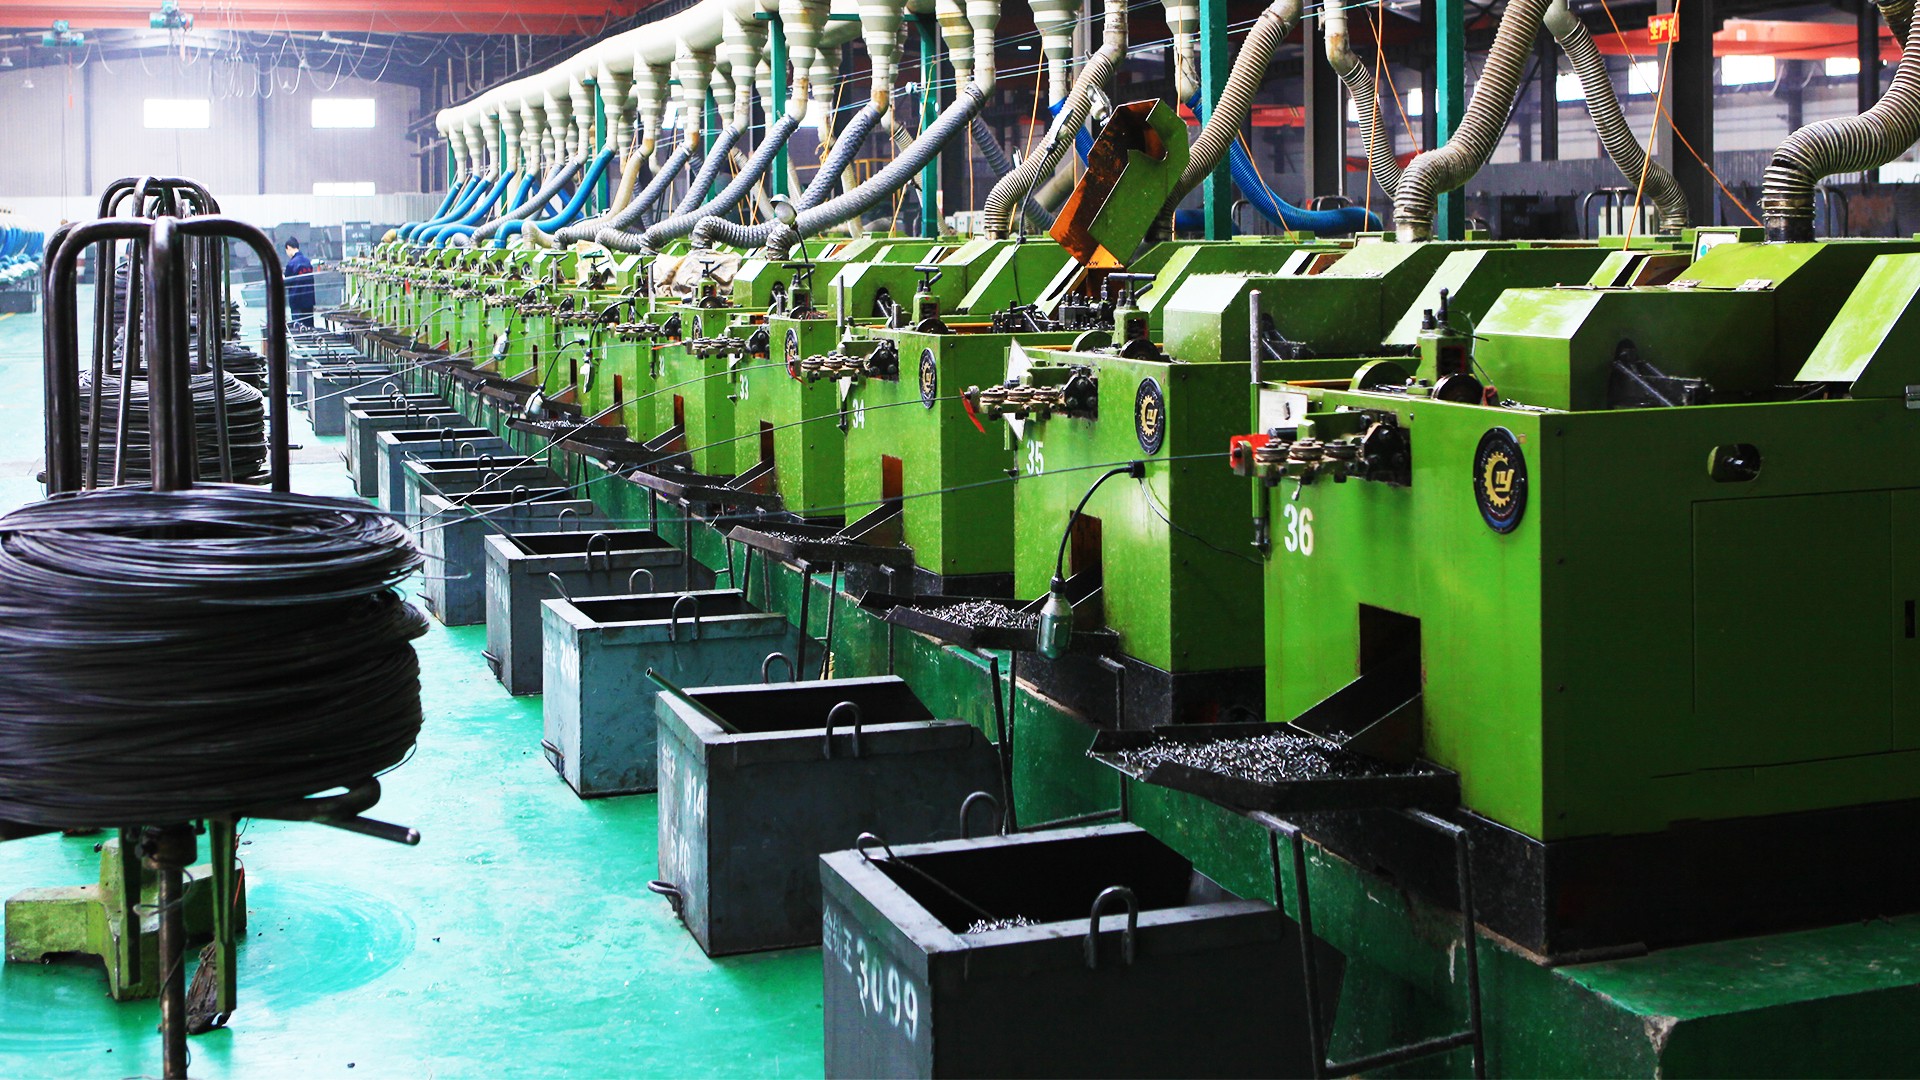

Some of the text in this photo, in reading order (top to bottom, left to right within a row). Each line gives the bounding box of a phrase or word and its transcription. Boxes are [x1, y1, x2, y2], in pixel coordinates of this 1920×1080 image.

[740, 374, 749, 400] 33
[852, 398, 865, 429] 34
[1026, 439, 1045, 477] 35
[1284, 503, 1314, 556] 36
[857, 937, 919, 1042] 3099
